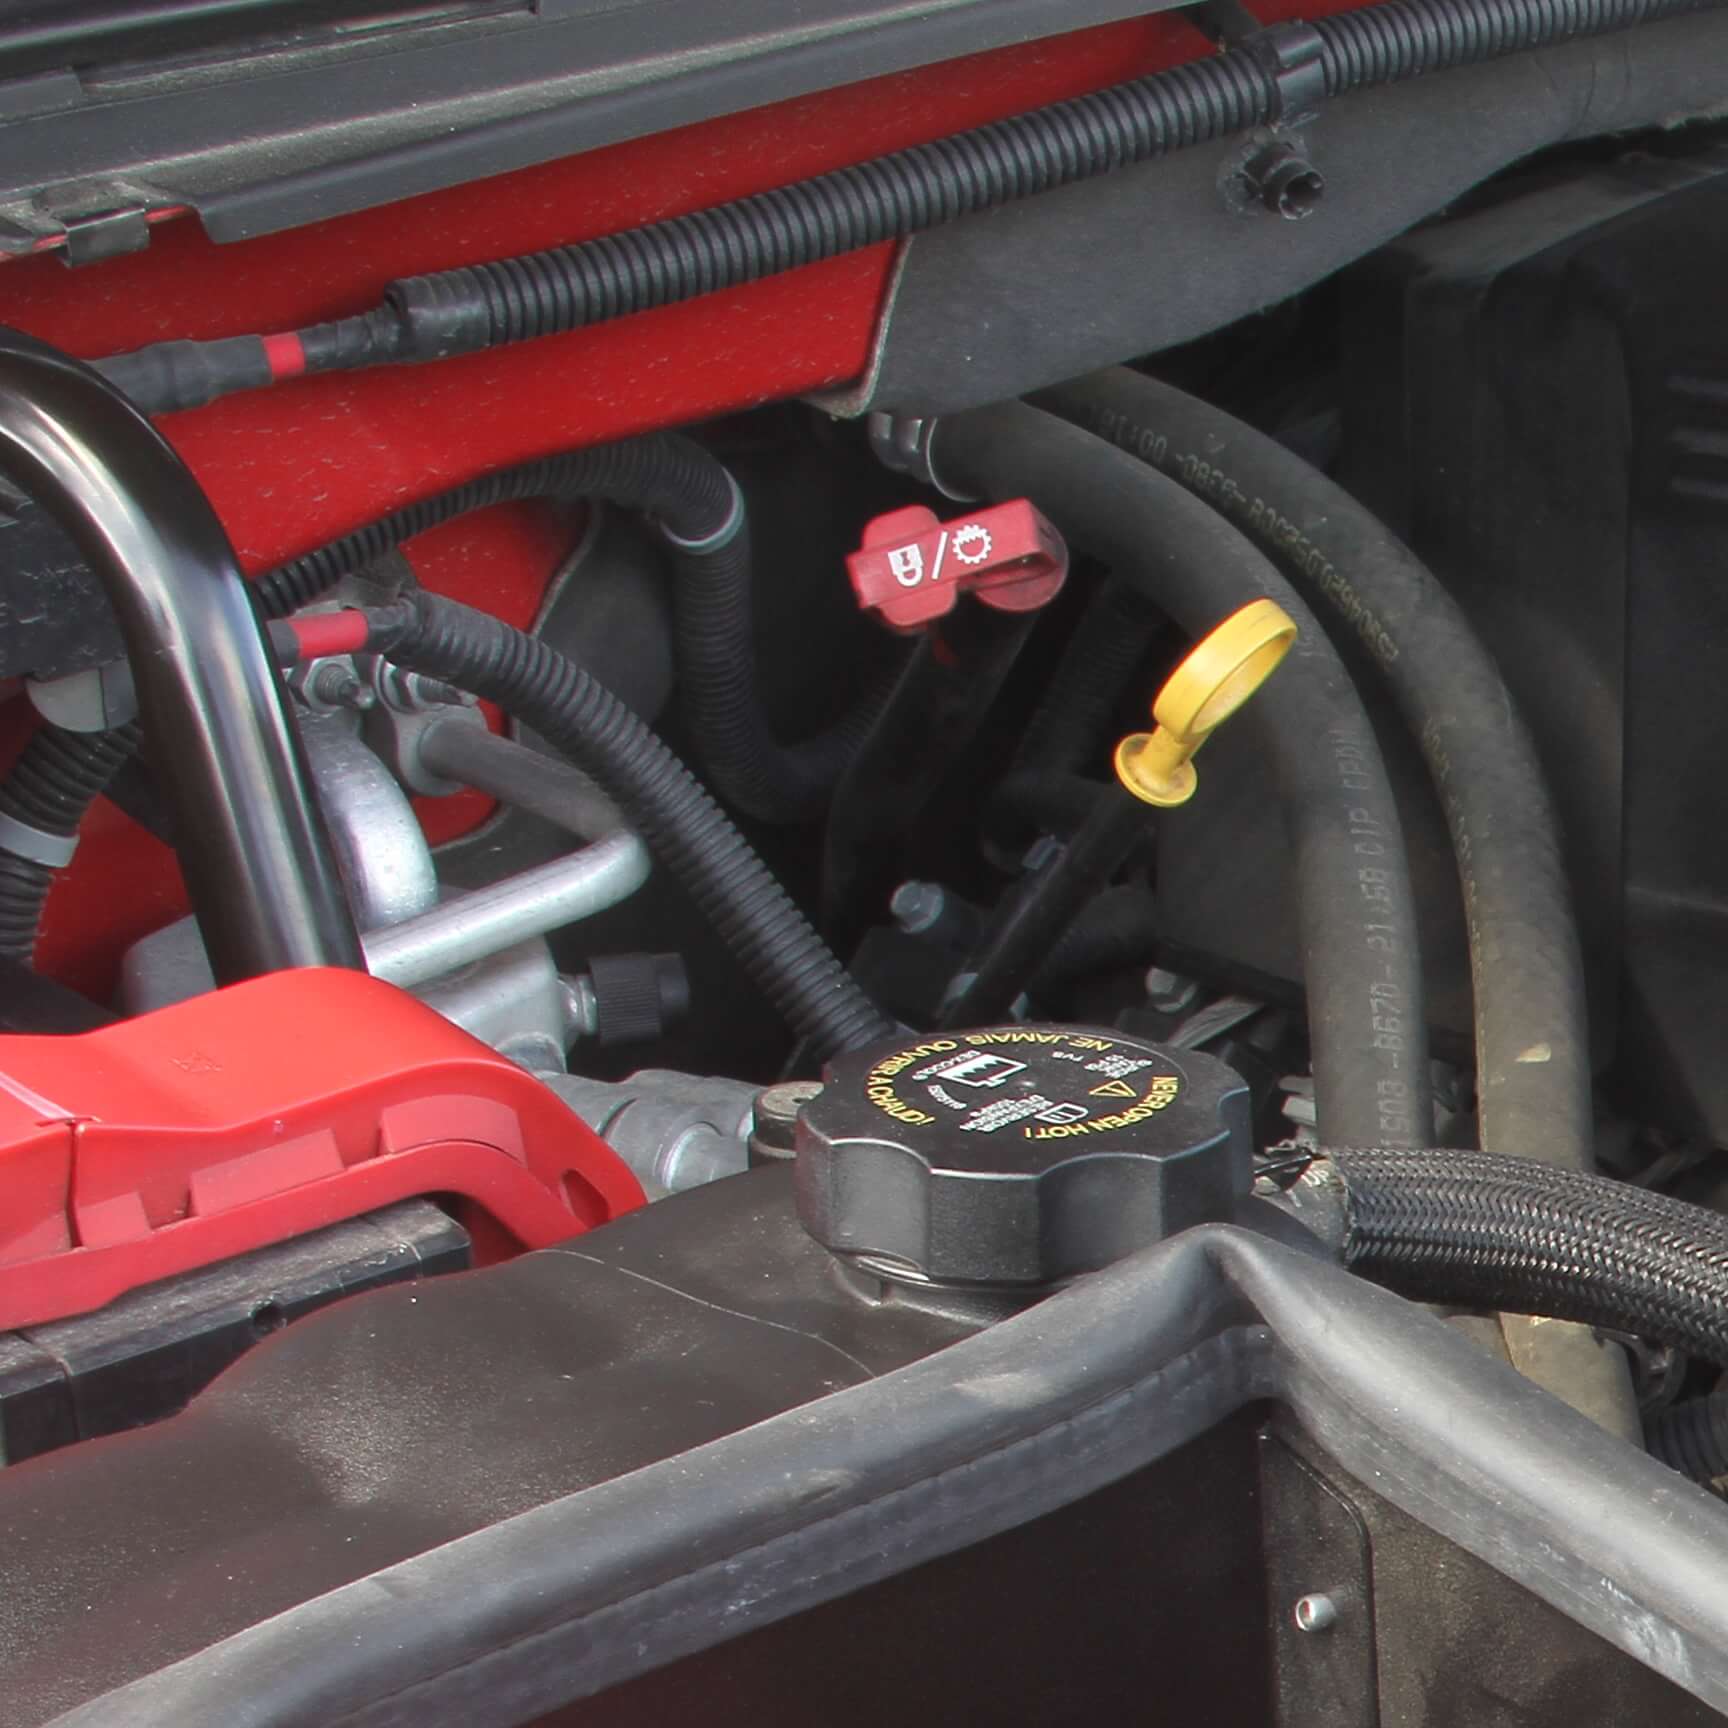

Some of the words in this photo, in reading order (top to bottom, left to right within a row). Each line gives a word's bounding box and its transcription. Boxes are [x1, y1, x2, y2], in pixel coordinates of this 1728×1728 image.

[965, 1031, 1069, 1046] JAMAIS
[1068, 1036, 1114, 1051] NE
[871, 1039, 959, 1077] OUVRIR
[1137, 1076, 1179, 1110] NEVER
[1087, 1107, 1154, 1132] OPEN
